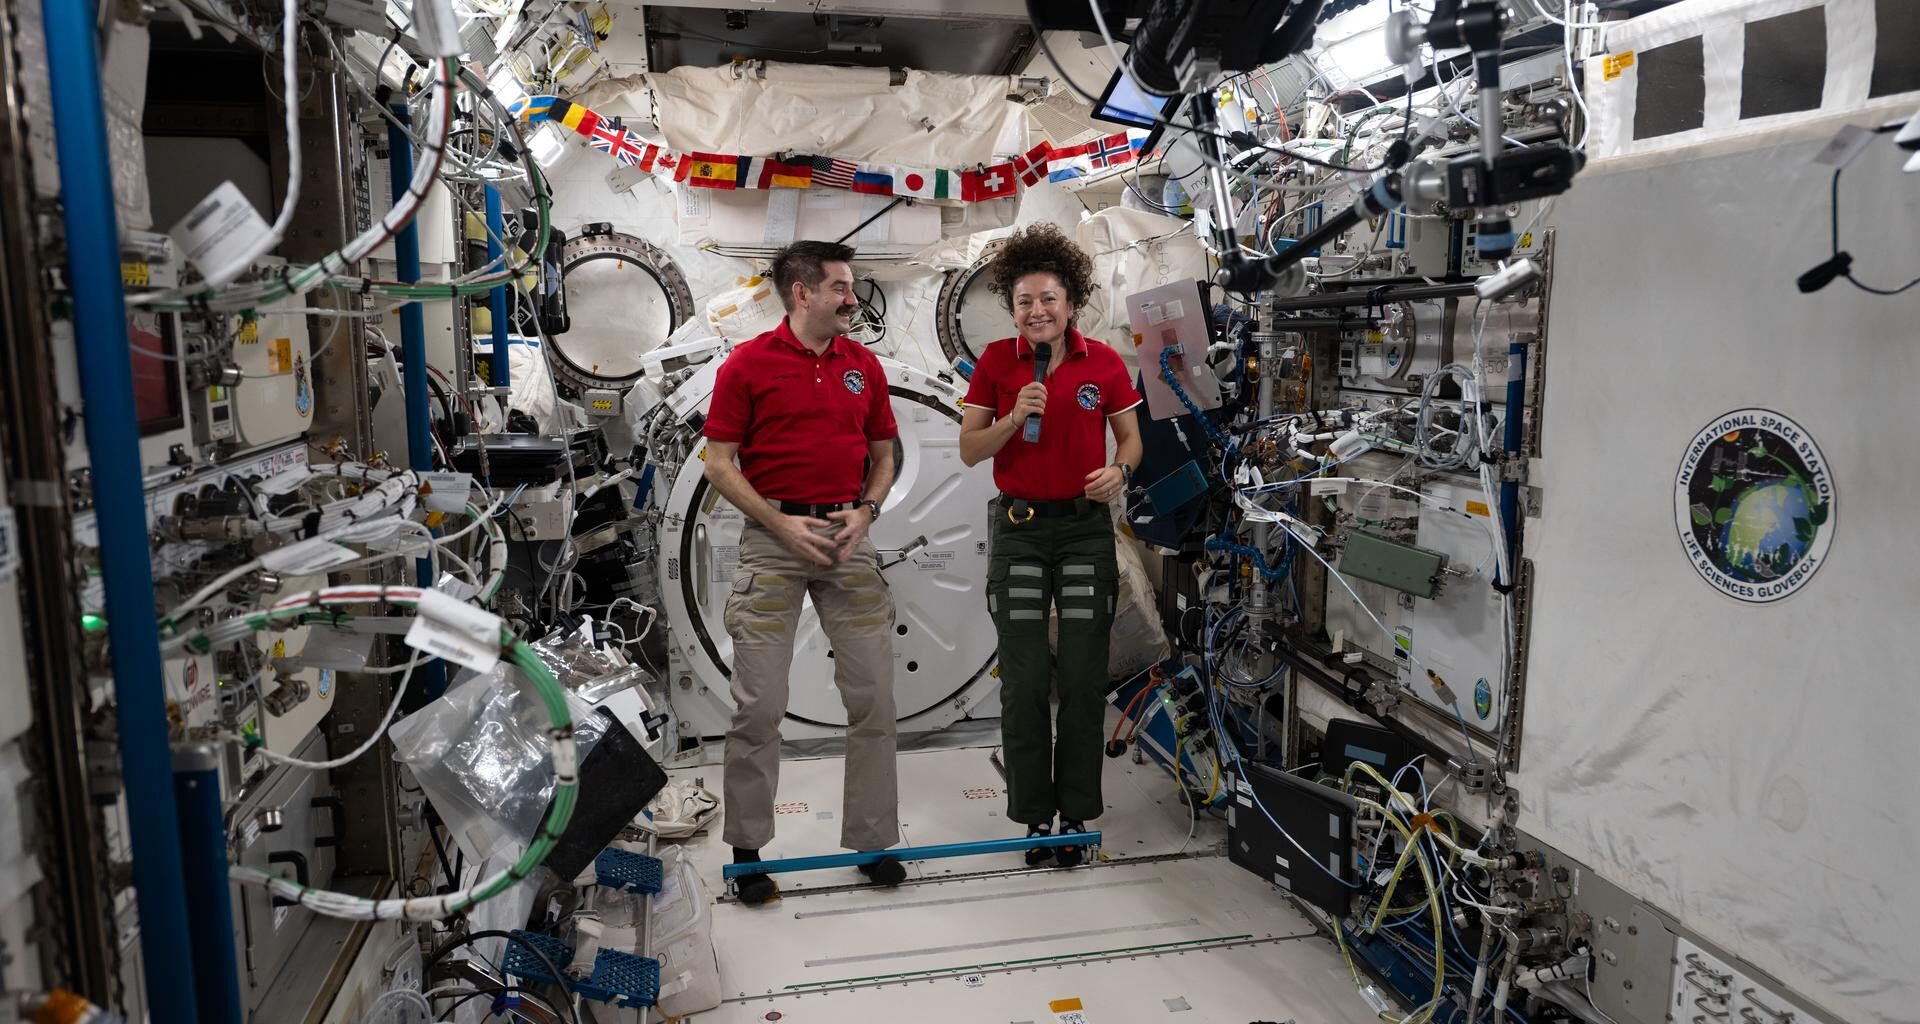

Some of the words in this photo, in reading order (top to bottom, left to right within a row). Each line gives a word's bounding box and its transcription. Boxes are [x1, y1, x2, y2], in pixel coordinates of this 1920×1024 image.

[1680, 415, 1757, 486] INTERNATIONAL
[1760, 416, 1801, 444] SPACE
[1799, 442, 1831, 505] STATION
[1683, 531, 1703, 561] LIFE
[1699, 559, 1754, 598] SCIENCES
[1758, 554, 1817, 598] GLOVEBOX
